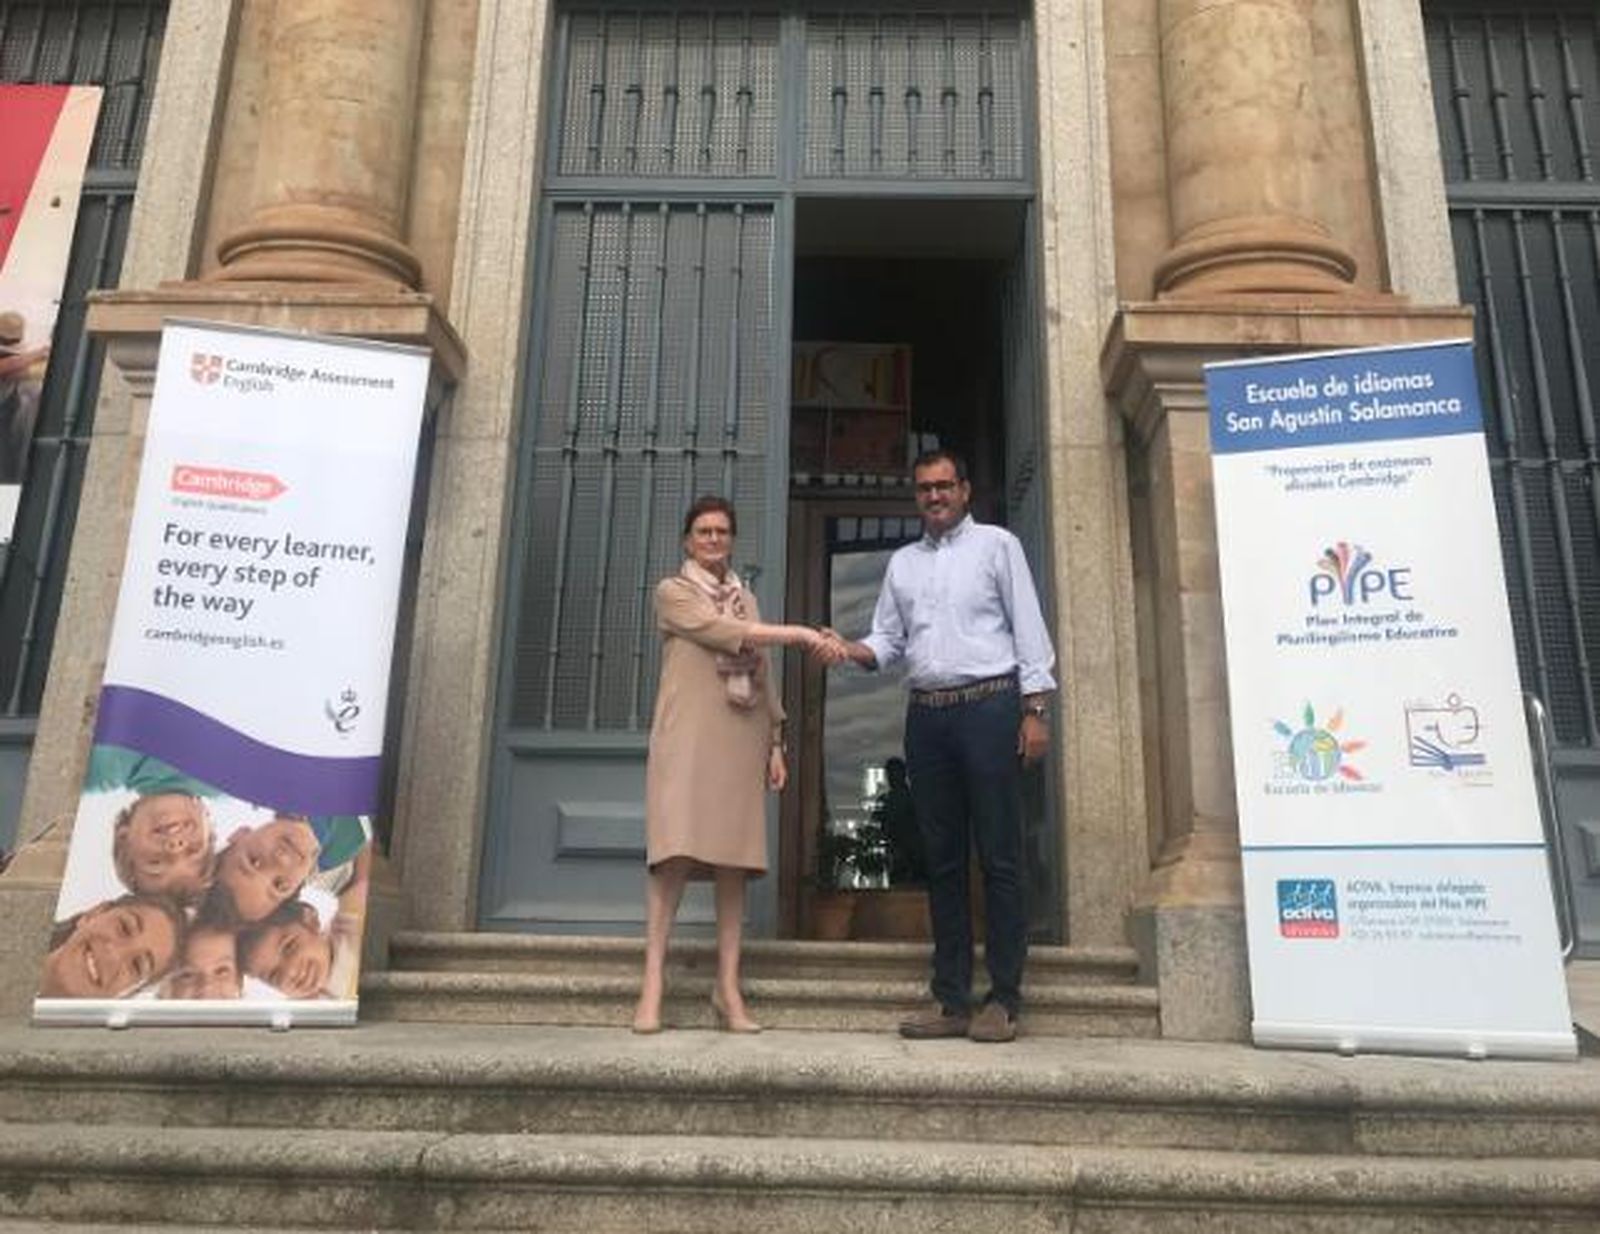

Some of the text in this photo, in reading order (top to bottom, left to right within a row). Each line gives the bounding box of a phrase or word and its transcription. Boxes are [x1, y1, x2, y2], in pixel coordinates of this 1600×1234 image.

[223, 374, 275, 394] English
[226, 357, 395, 389] Cambridge Assessment
[1245, 371, 1435, 404] Escuela de idiomas
[1226, 397, 1462, 434] San Agustín Salamanca
[1349, 458, 1365, 471] de
[179, 470, 272, 498] Cambridge
[163, 522, 375, 565] For every learner,
[157, 557, 321, 592] every step of
[153, 584, 254, 621] the way
[1343, 611, 1400, 628] Integral
[1404, 609, 1424, 623] de
[1385, 626, 1459, 641] Educativo
